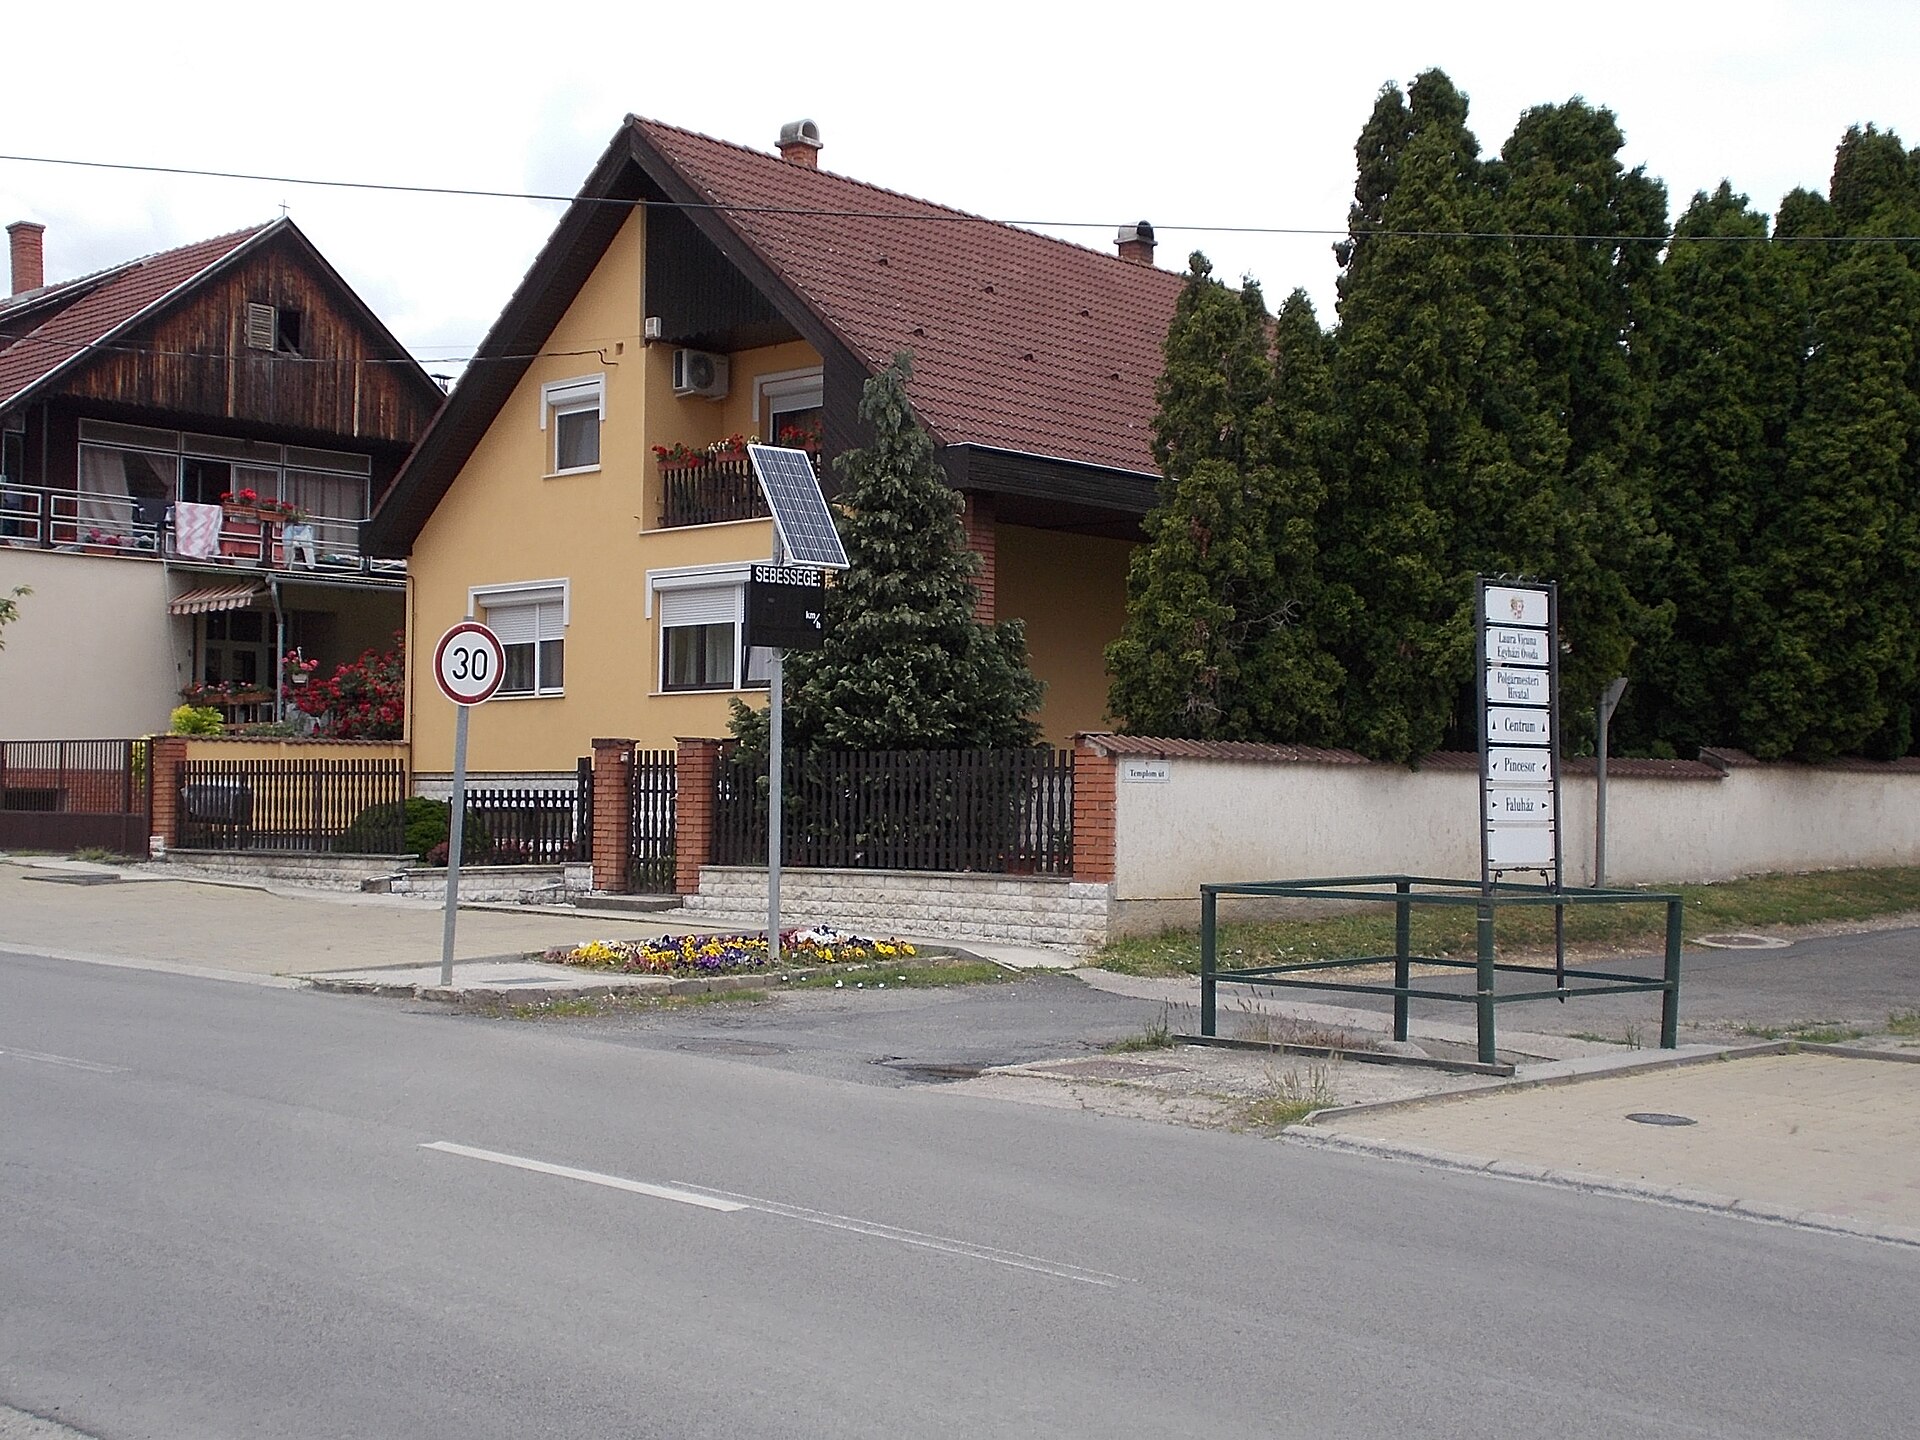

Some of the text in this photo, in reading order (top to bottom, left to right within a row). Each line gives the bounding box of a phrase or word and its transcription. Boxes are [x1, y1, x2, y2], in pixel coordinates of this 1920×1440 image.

[1499, 632, 1517, 644] Laura
[452, 647, 488, 681] 30
[1497, 671, 1539, 687] Polgármesteri
[1508, 687, 1530, 699] Hivatal
[1504, 717, 1536, 733] Centrum
[1504, 757, 1537, 773] Pincesor
[1130, 769, 1157, 778] Templom
[1506, 797, 1535, 812] Faluház
